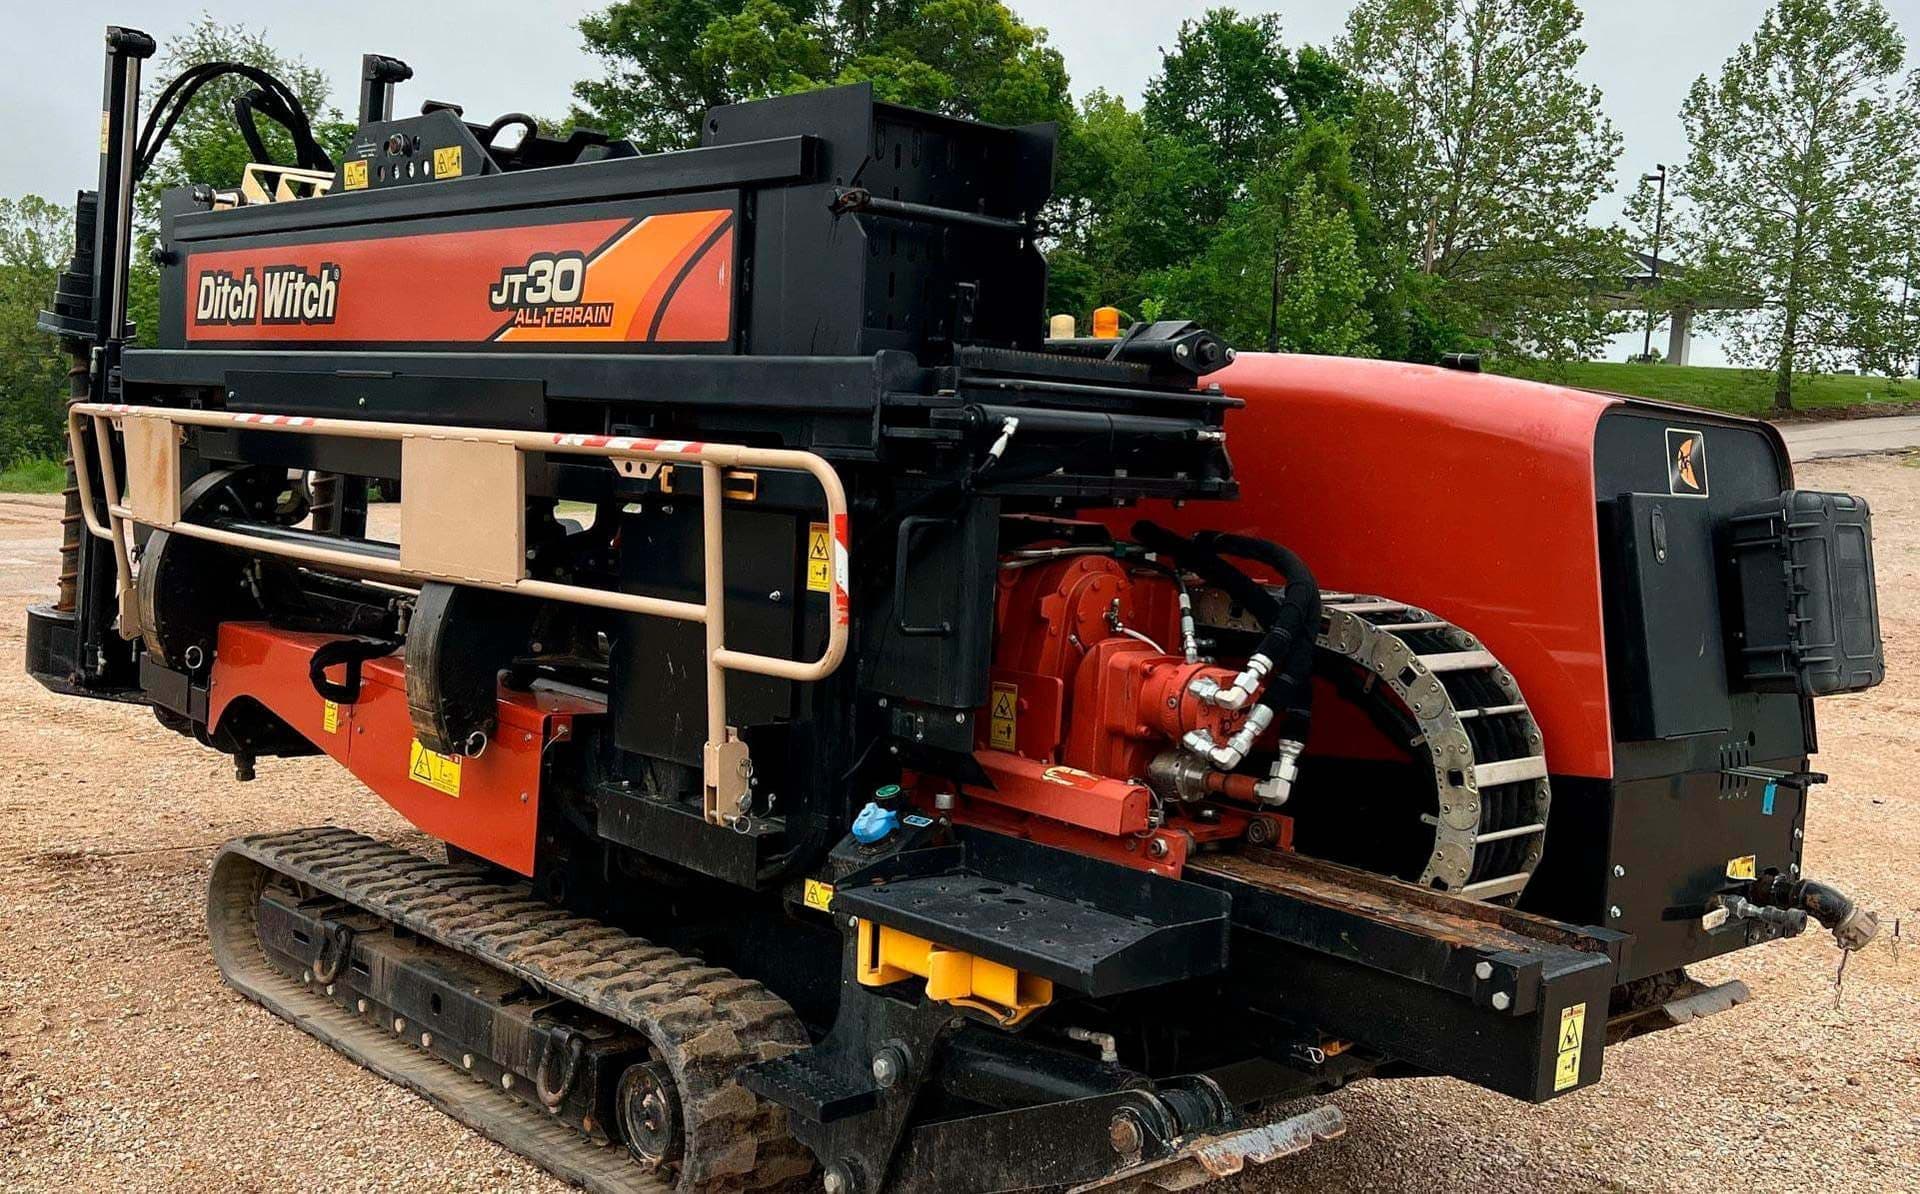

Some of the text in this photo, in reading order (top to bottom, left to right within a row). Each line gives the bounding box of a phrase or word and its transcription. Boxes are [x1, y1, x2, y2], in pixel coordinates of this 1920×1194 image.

[196, 272, 259, 321] Ditch
[491, 257, 584, 305] JT30
[514, 305, 612, 325] ALL TERRAIN
